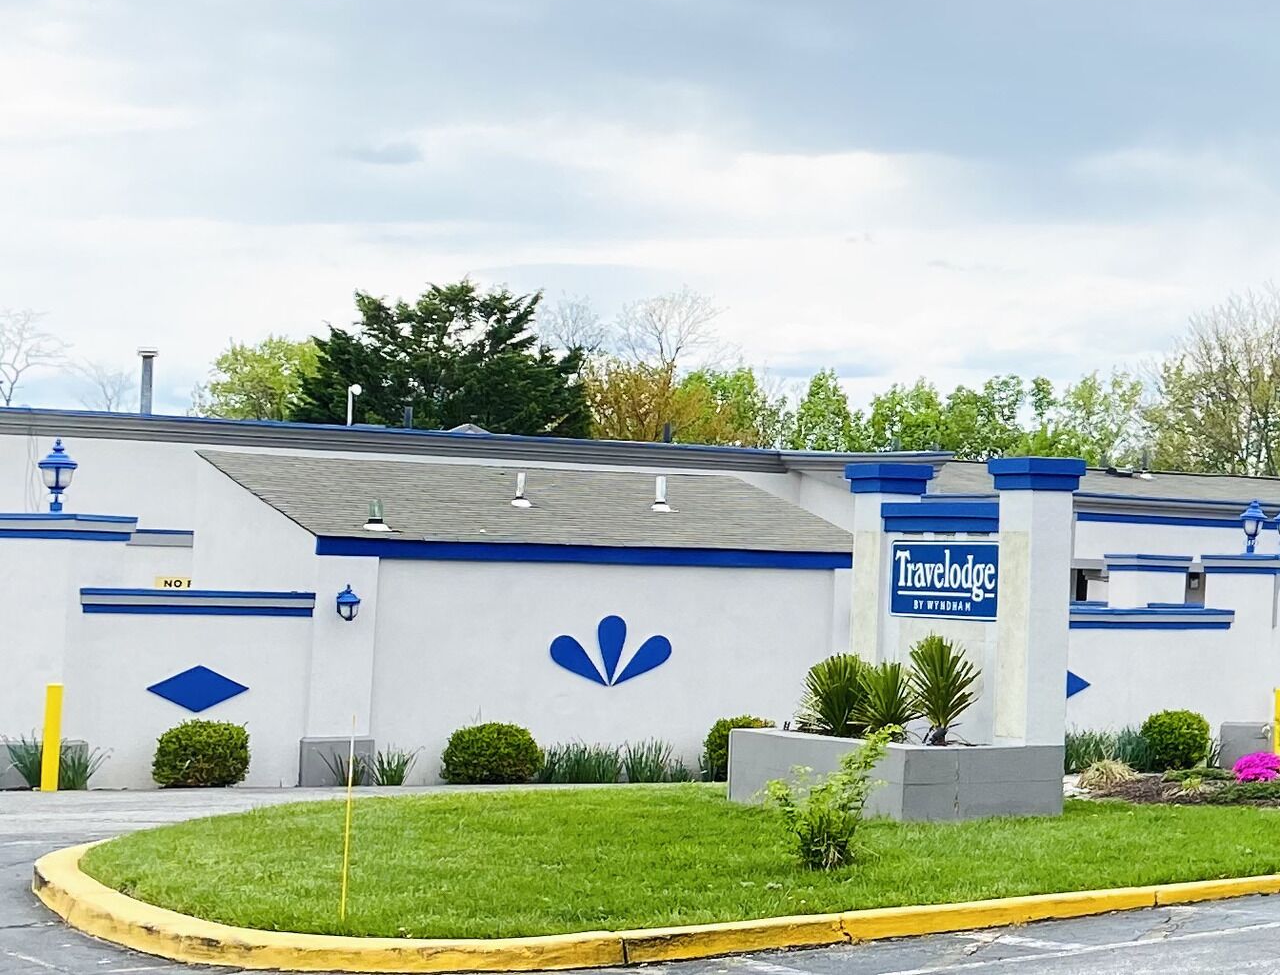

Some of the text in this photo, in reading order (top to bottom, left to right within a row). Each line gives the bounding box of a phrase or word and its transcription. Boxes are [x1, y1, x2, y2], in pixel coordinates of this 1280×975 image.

[895, 549, 996, 602] Travelodge
[163, 579, 183, 588] NO
[913, 599, 971, 612] BY WYNDHAM
